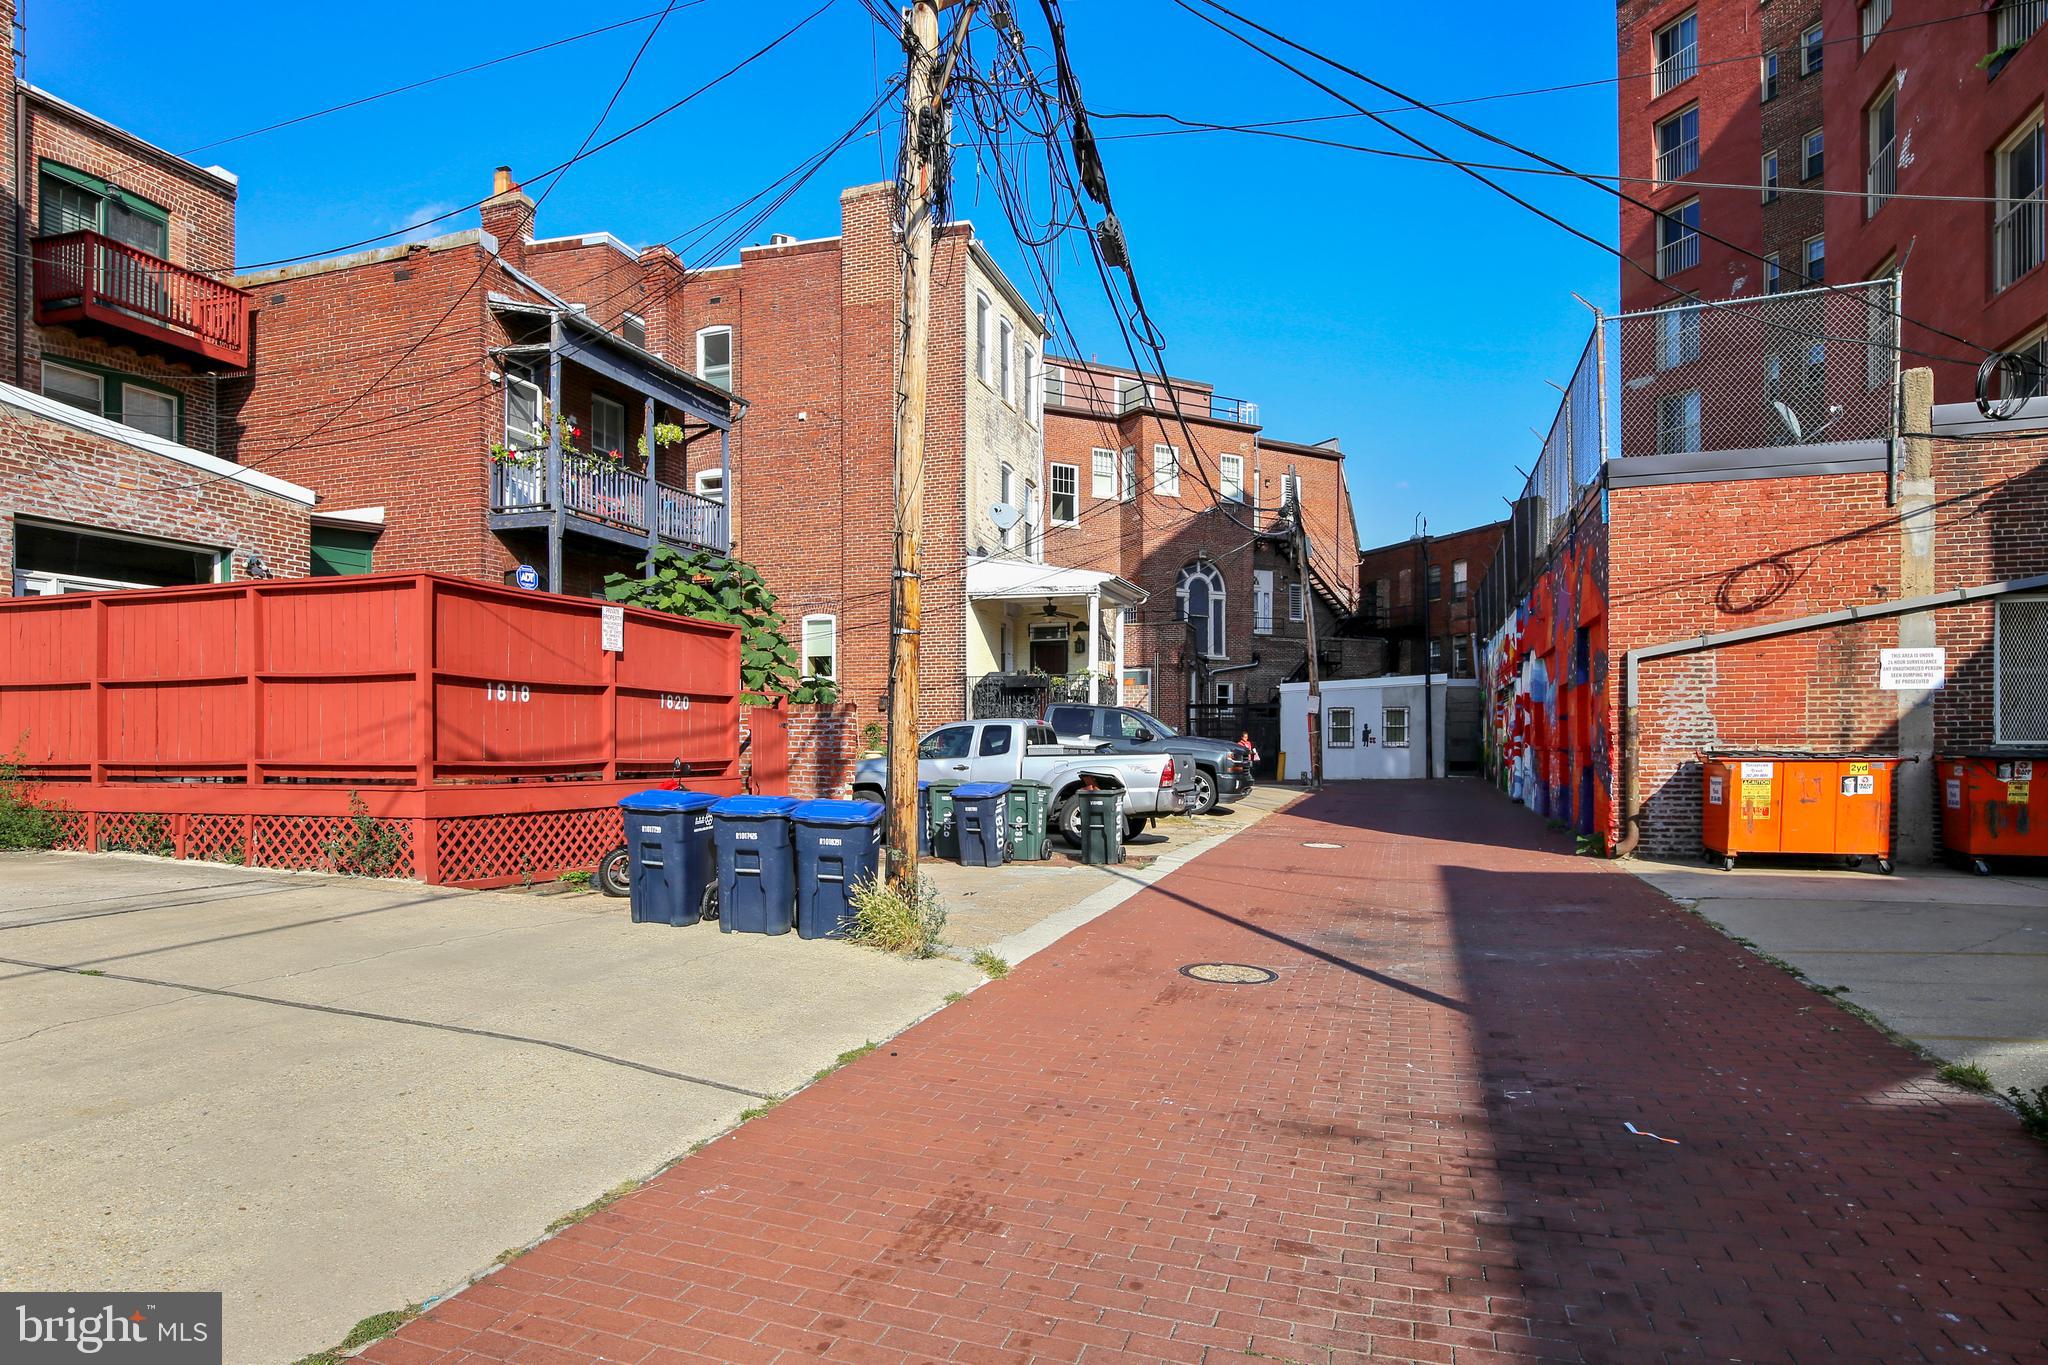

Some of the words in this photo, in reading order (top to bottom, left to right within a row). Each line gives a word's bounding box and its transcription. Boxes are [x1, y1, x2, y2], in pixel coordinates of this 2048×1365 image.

[521, 572, 535, 582] ADT
[487, 682, 530, 703] 1818
[660, 693, 689, 711] 1820
[1851, 764, 1868, 773] 2yd
[943, 811, 953, 838] 1820
[995, 808, 1004, 849] 1820
